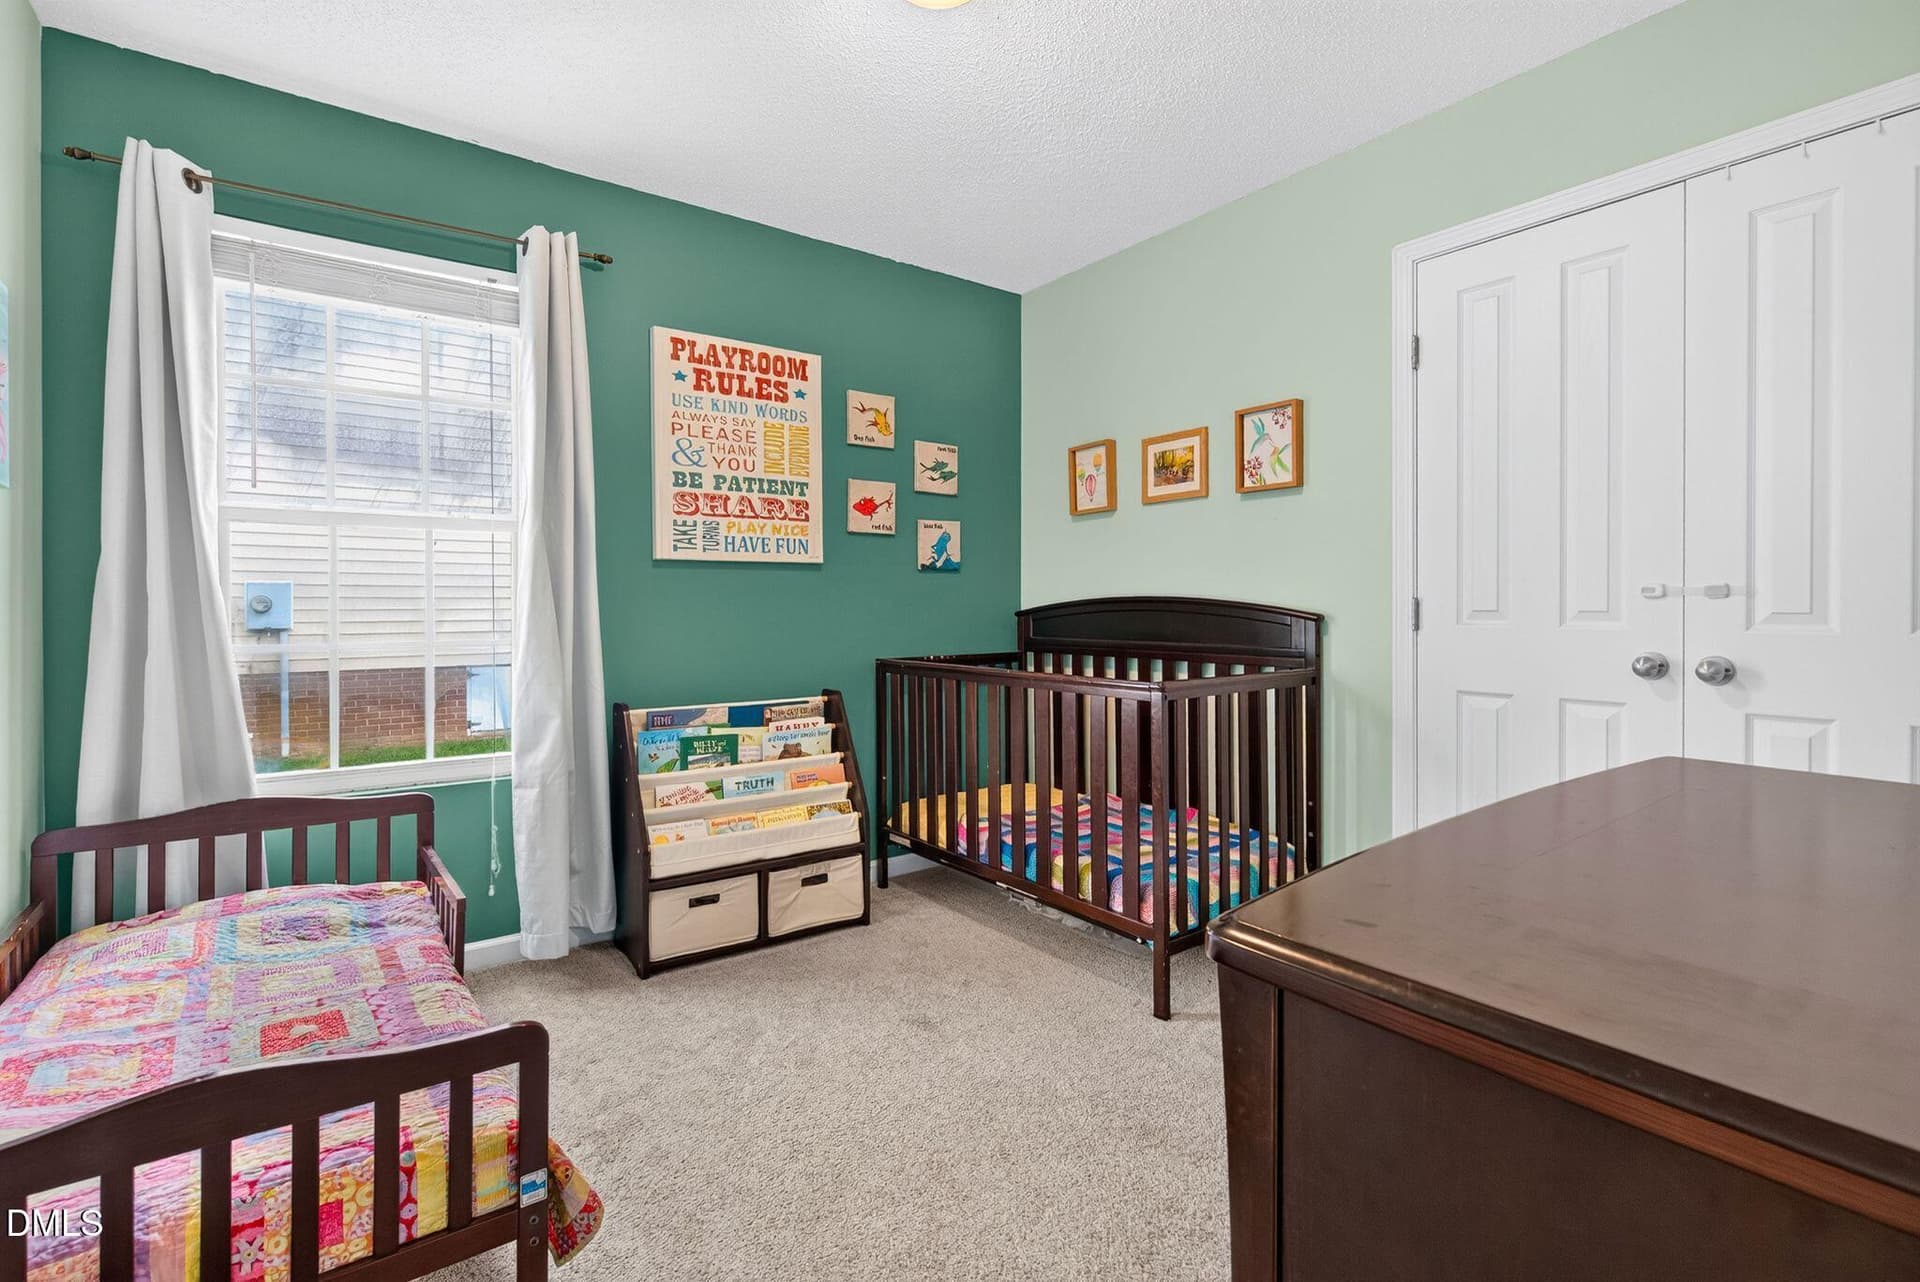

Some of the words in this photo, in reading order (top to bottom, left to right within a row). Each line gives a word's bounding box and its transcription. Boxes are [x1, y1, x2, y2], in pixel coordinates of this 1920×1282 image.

[670, 336, 809, 382] PLAYROOM
[693, 367, 789, 404] RULES
[671, 393, 704, 411] USE
[711, 398, 748, 415] KIND
[755, 403, 808, 423] WORDS
[671, 410, 728, 425] ALWAYS
[732, 417, 757, 428] SAY
[671, 422, 757, 444] PLEASE
[763, 421, 785, 475] INCLUDE
[672, 437, 707, 468] &
[708, 441, 757, 457] THANK
[712, 456, 756, 473] YOU
[788, 423, 810, 478] EVERYONE
[672, 470, 703, 489] BE
[713, 474, 809, 497] PATIENT
[672, 491, 810, 522] SHARE
[672, 519, 698, 552] TAKE
[702, 520, 720, 552] TURNS
[726, 520, 767, 535] PLAY
[771, 523, 809, 537] NICE
[723, 535, 771, 554] HAVE
[775, 537, 809, 555] FUN
[735, 776, 774, 791] TRUTH
